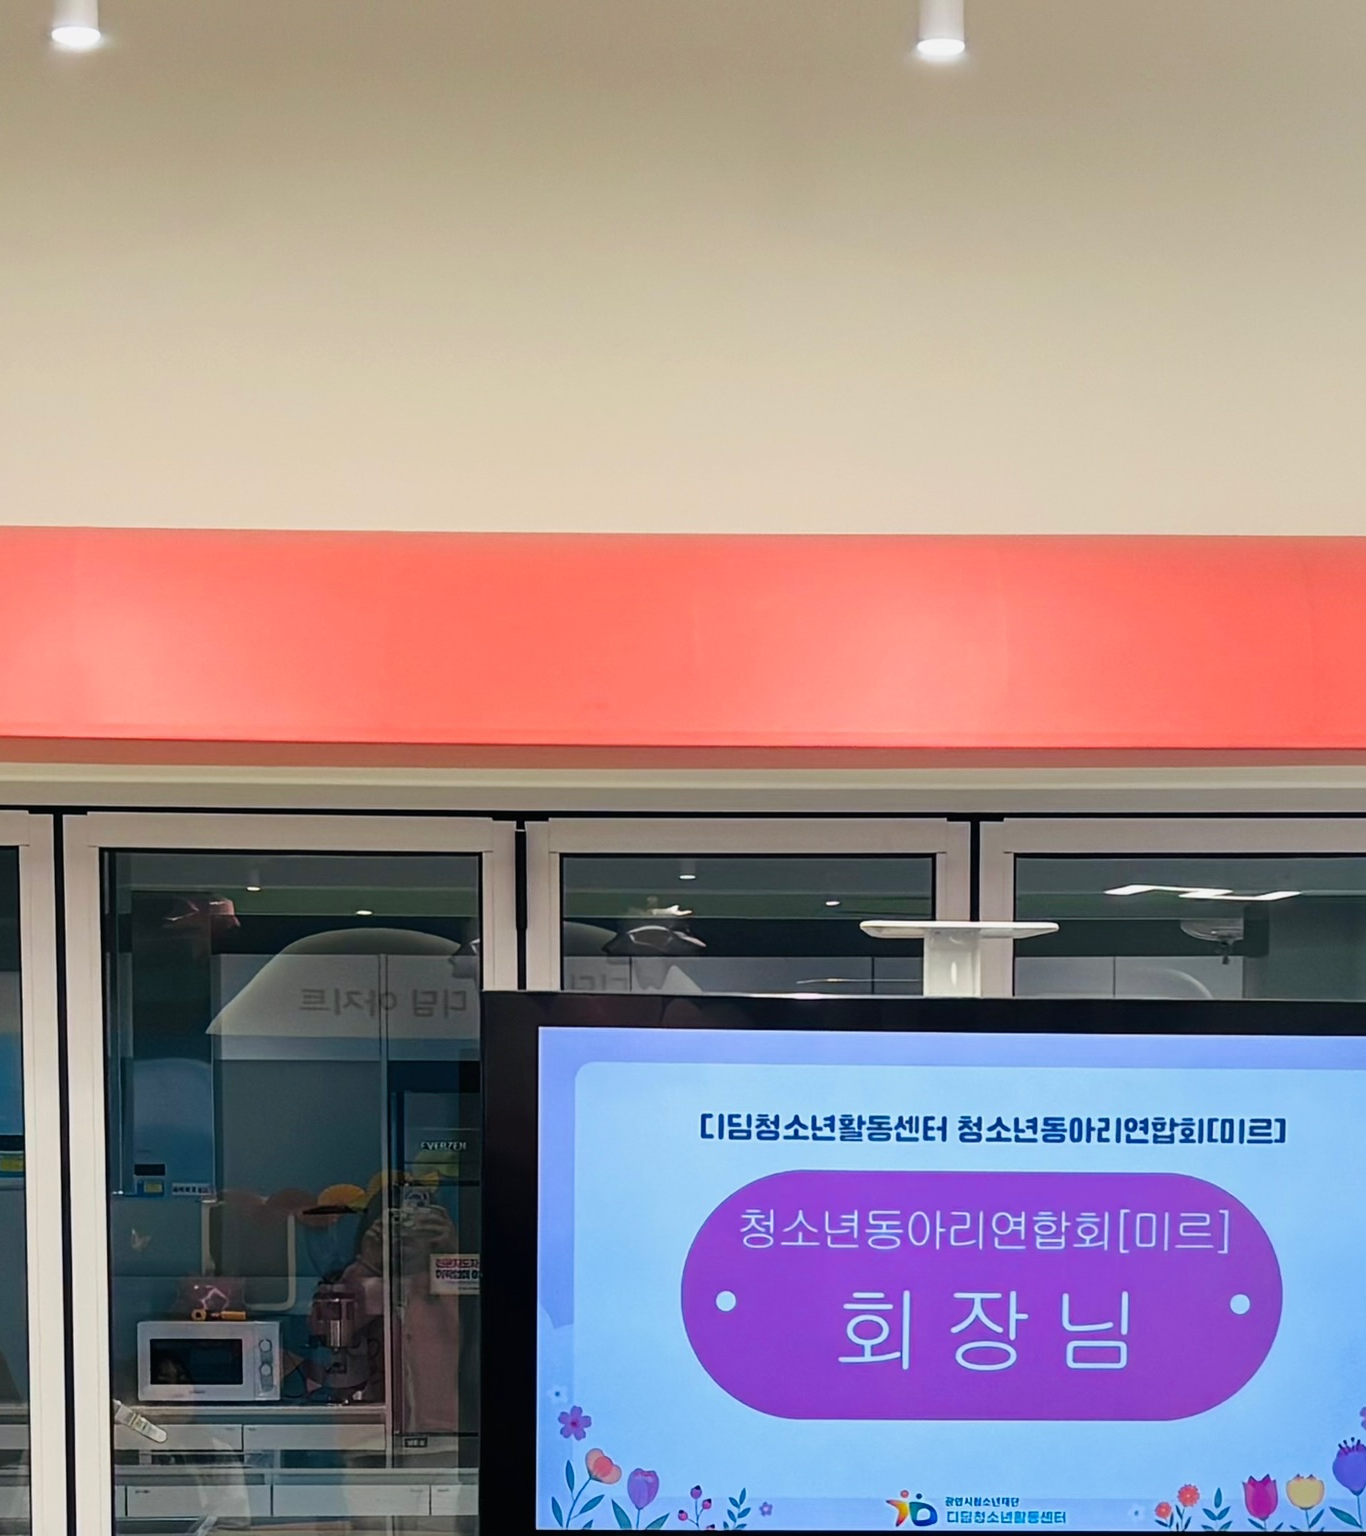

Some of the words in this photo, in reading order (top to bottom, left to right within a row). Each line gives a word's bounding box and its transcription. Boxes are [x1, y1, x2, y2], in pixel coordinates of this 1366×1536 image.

[700, 1113, 948, 1143] 디딤청소년활동센터
[958, 1115, 1286, 1145] 청소년동아리연합회[미르]
[739, 1208, 1229, 1254] 청소년동아리연합회[미르]
[947, 1511, 1066, 1524] 디딤청소년활동센터
